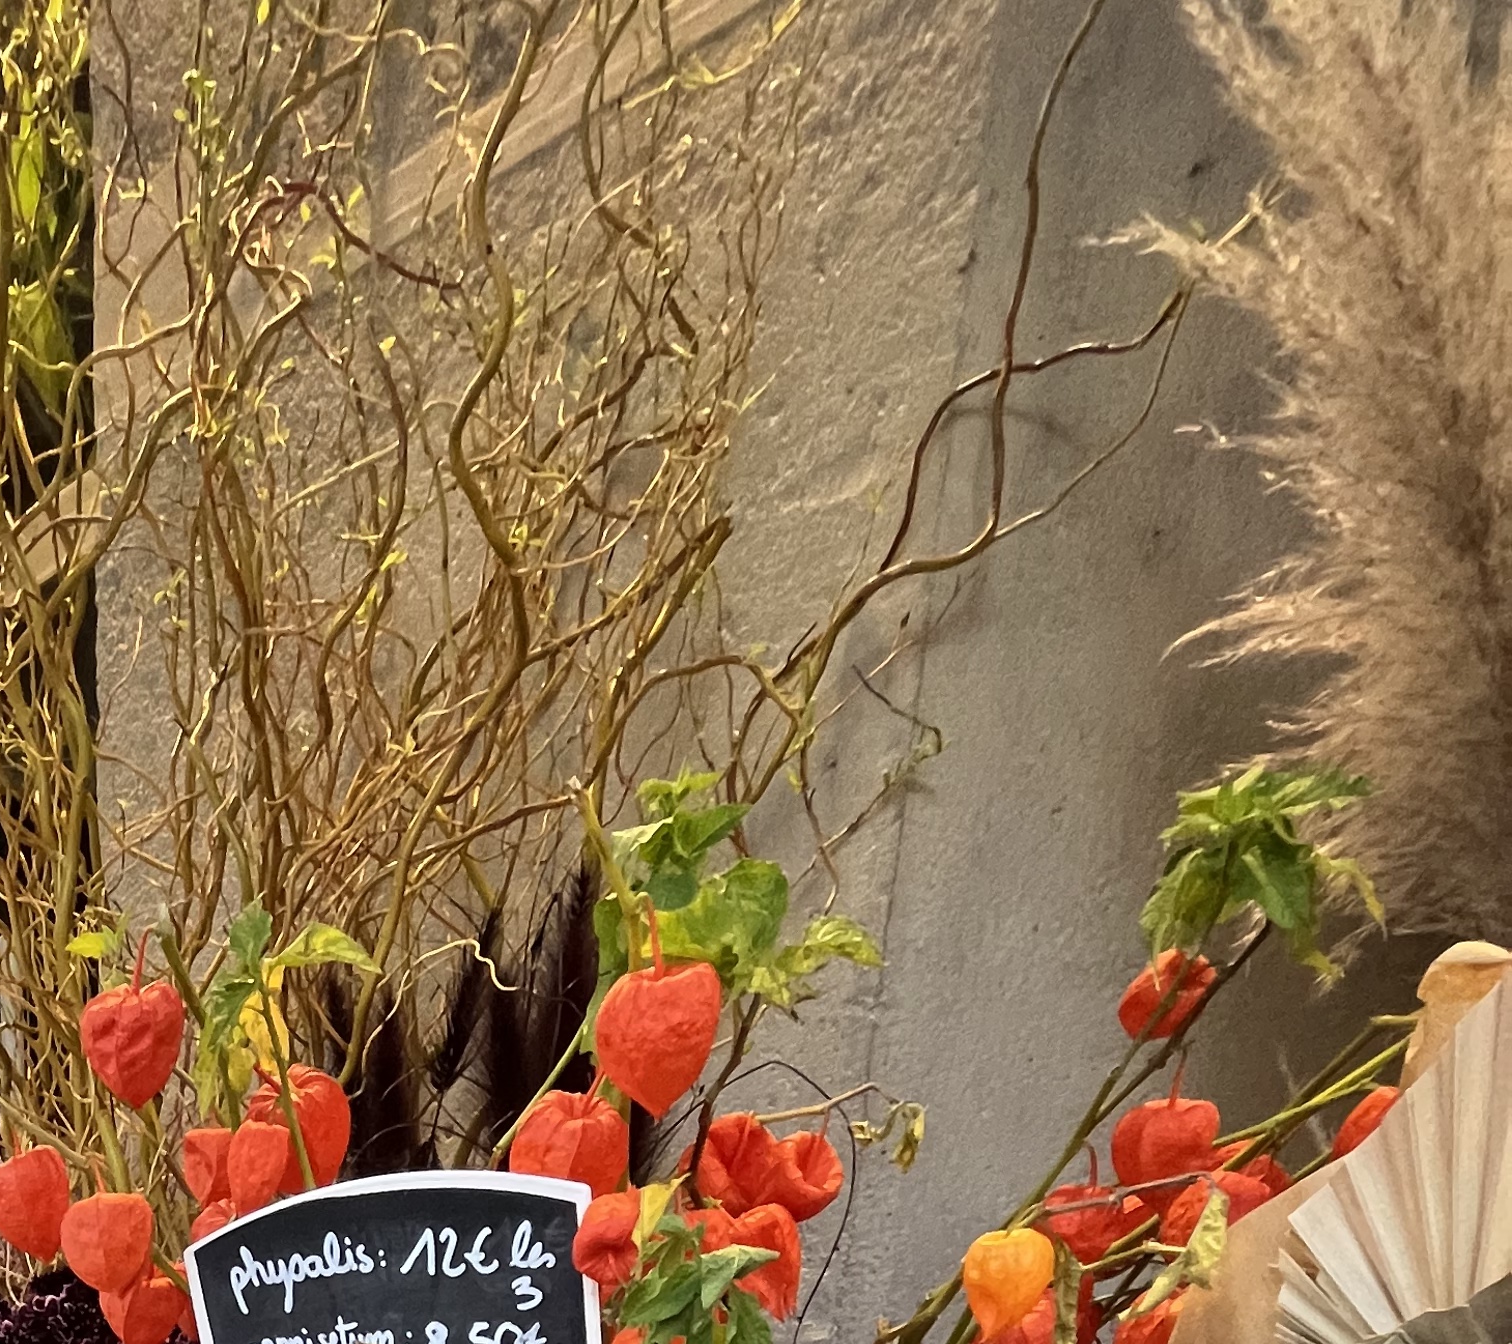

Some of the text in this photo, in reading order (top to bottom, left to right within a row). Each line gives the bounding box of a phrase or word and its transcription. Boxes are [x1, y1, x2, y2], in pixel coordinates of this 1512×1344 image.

[400, 1226, 499, 1278] 12€
[508, 1219, 557, 1269] les
[511, 1276, 543, 1311] 3
